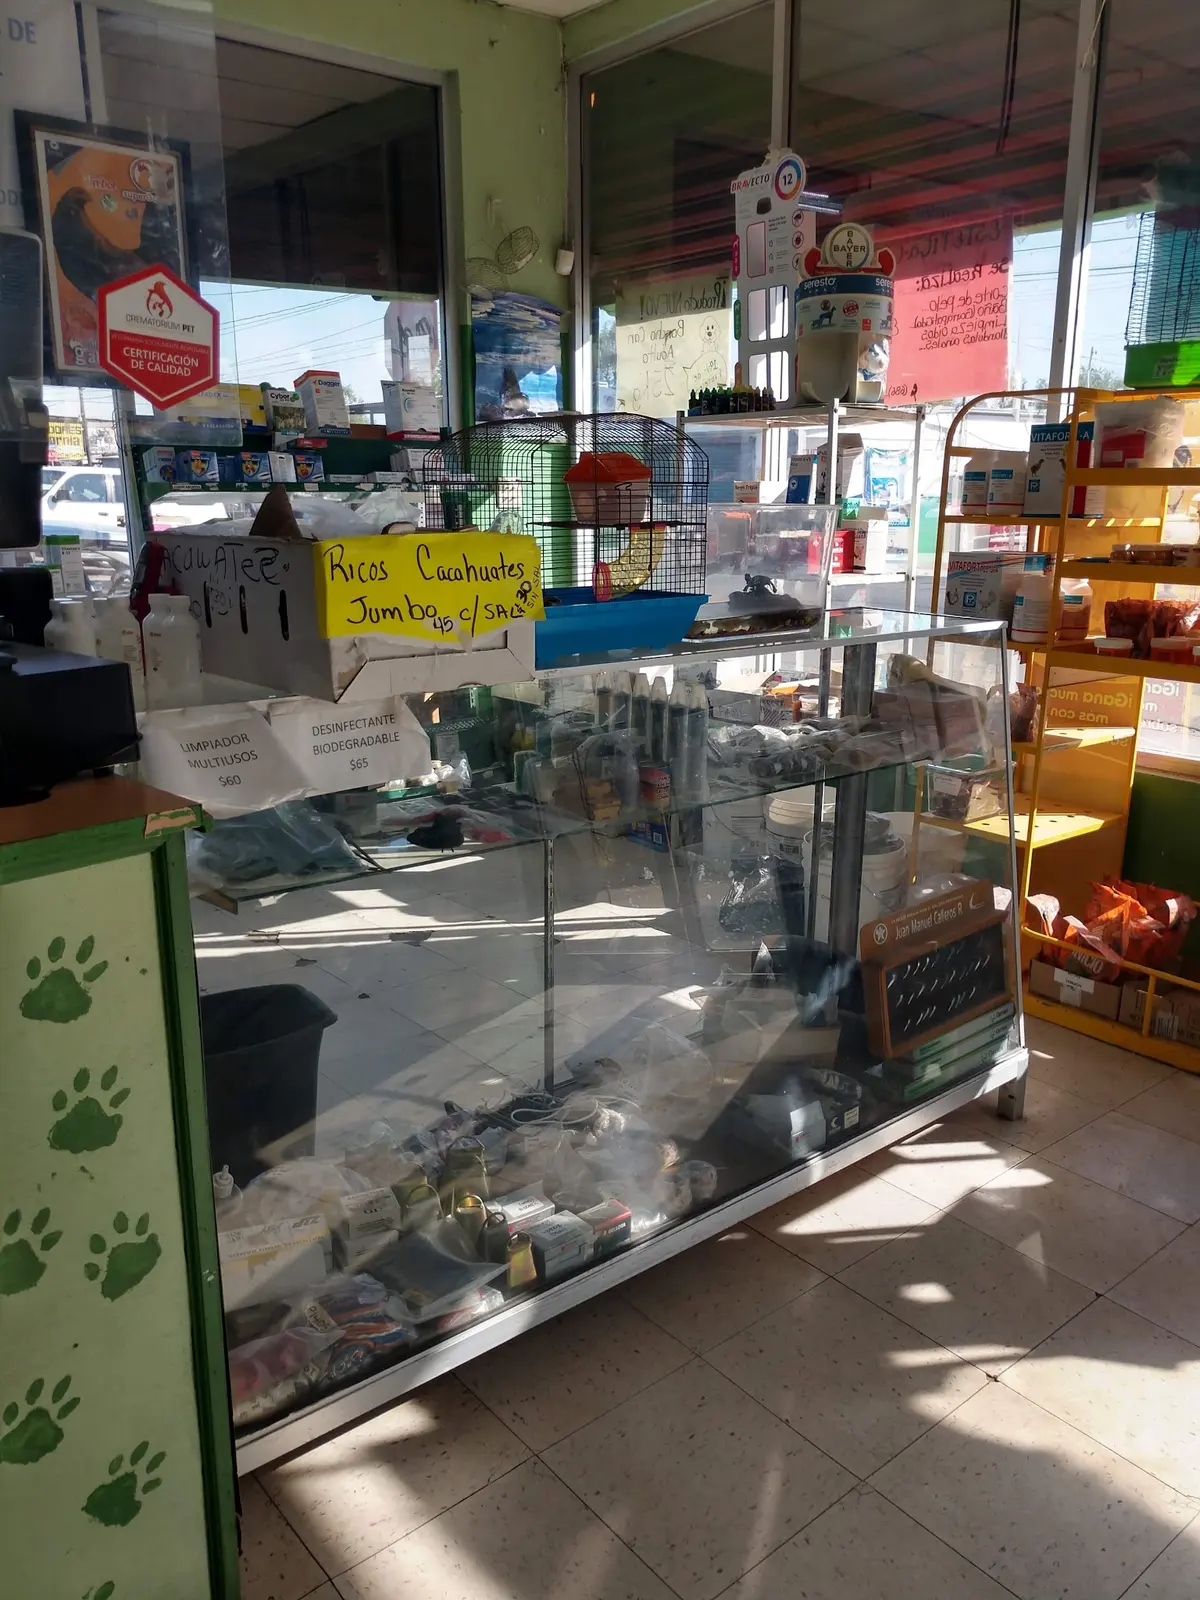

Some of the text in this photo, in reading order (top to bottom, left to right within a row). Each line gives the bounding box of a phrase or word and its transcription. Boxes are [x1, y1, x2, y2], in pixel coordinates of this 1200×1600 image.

[7, 17, 38, 45] DE
[731, 173, 771, 192] BRAVECTO
[783, 173, 793, 186] 12
[833, 244, 866, 253] BAYER
[803, 277, 837, 290] seresto
[125, 313, 195, 333] CREMATORIUM PET
[123, 346, 199, 367] CERTIFICACIÓN
[131, 359, 191, 377] DE CALIDAD
[318, 379, 340, 388] Dagger
[416, 543, 525, 583] Cacahuates
[347, 594, 438, 624] Jumbo
[434, 616, 454, 636] 45
[312, 713, 396, 737] DESINFECTANTE
[180, 733, 250, 753] LIMPIADOR
[312, 731, 401, 756] BIODEGRADABLE
[187, 749, 258, 769] MULTIUSOS
[349, 757, 369, 771] $65
[218, 775, 242, 787] $60
[895, 925, 910, 941] Juan
[911, 914, 933, 936] Manuel
